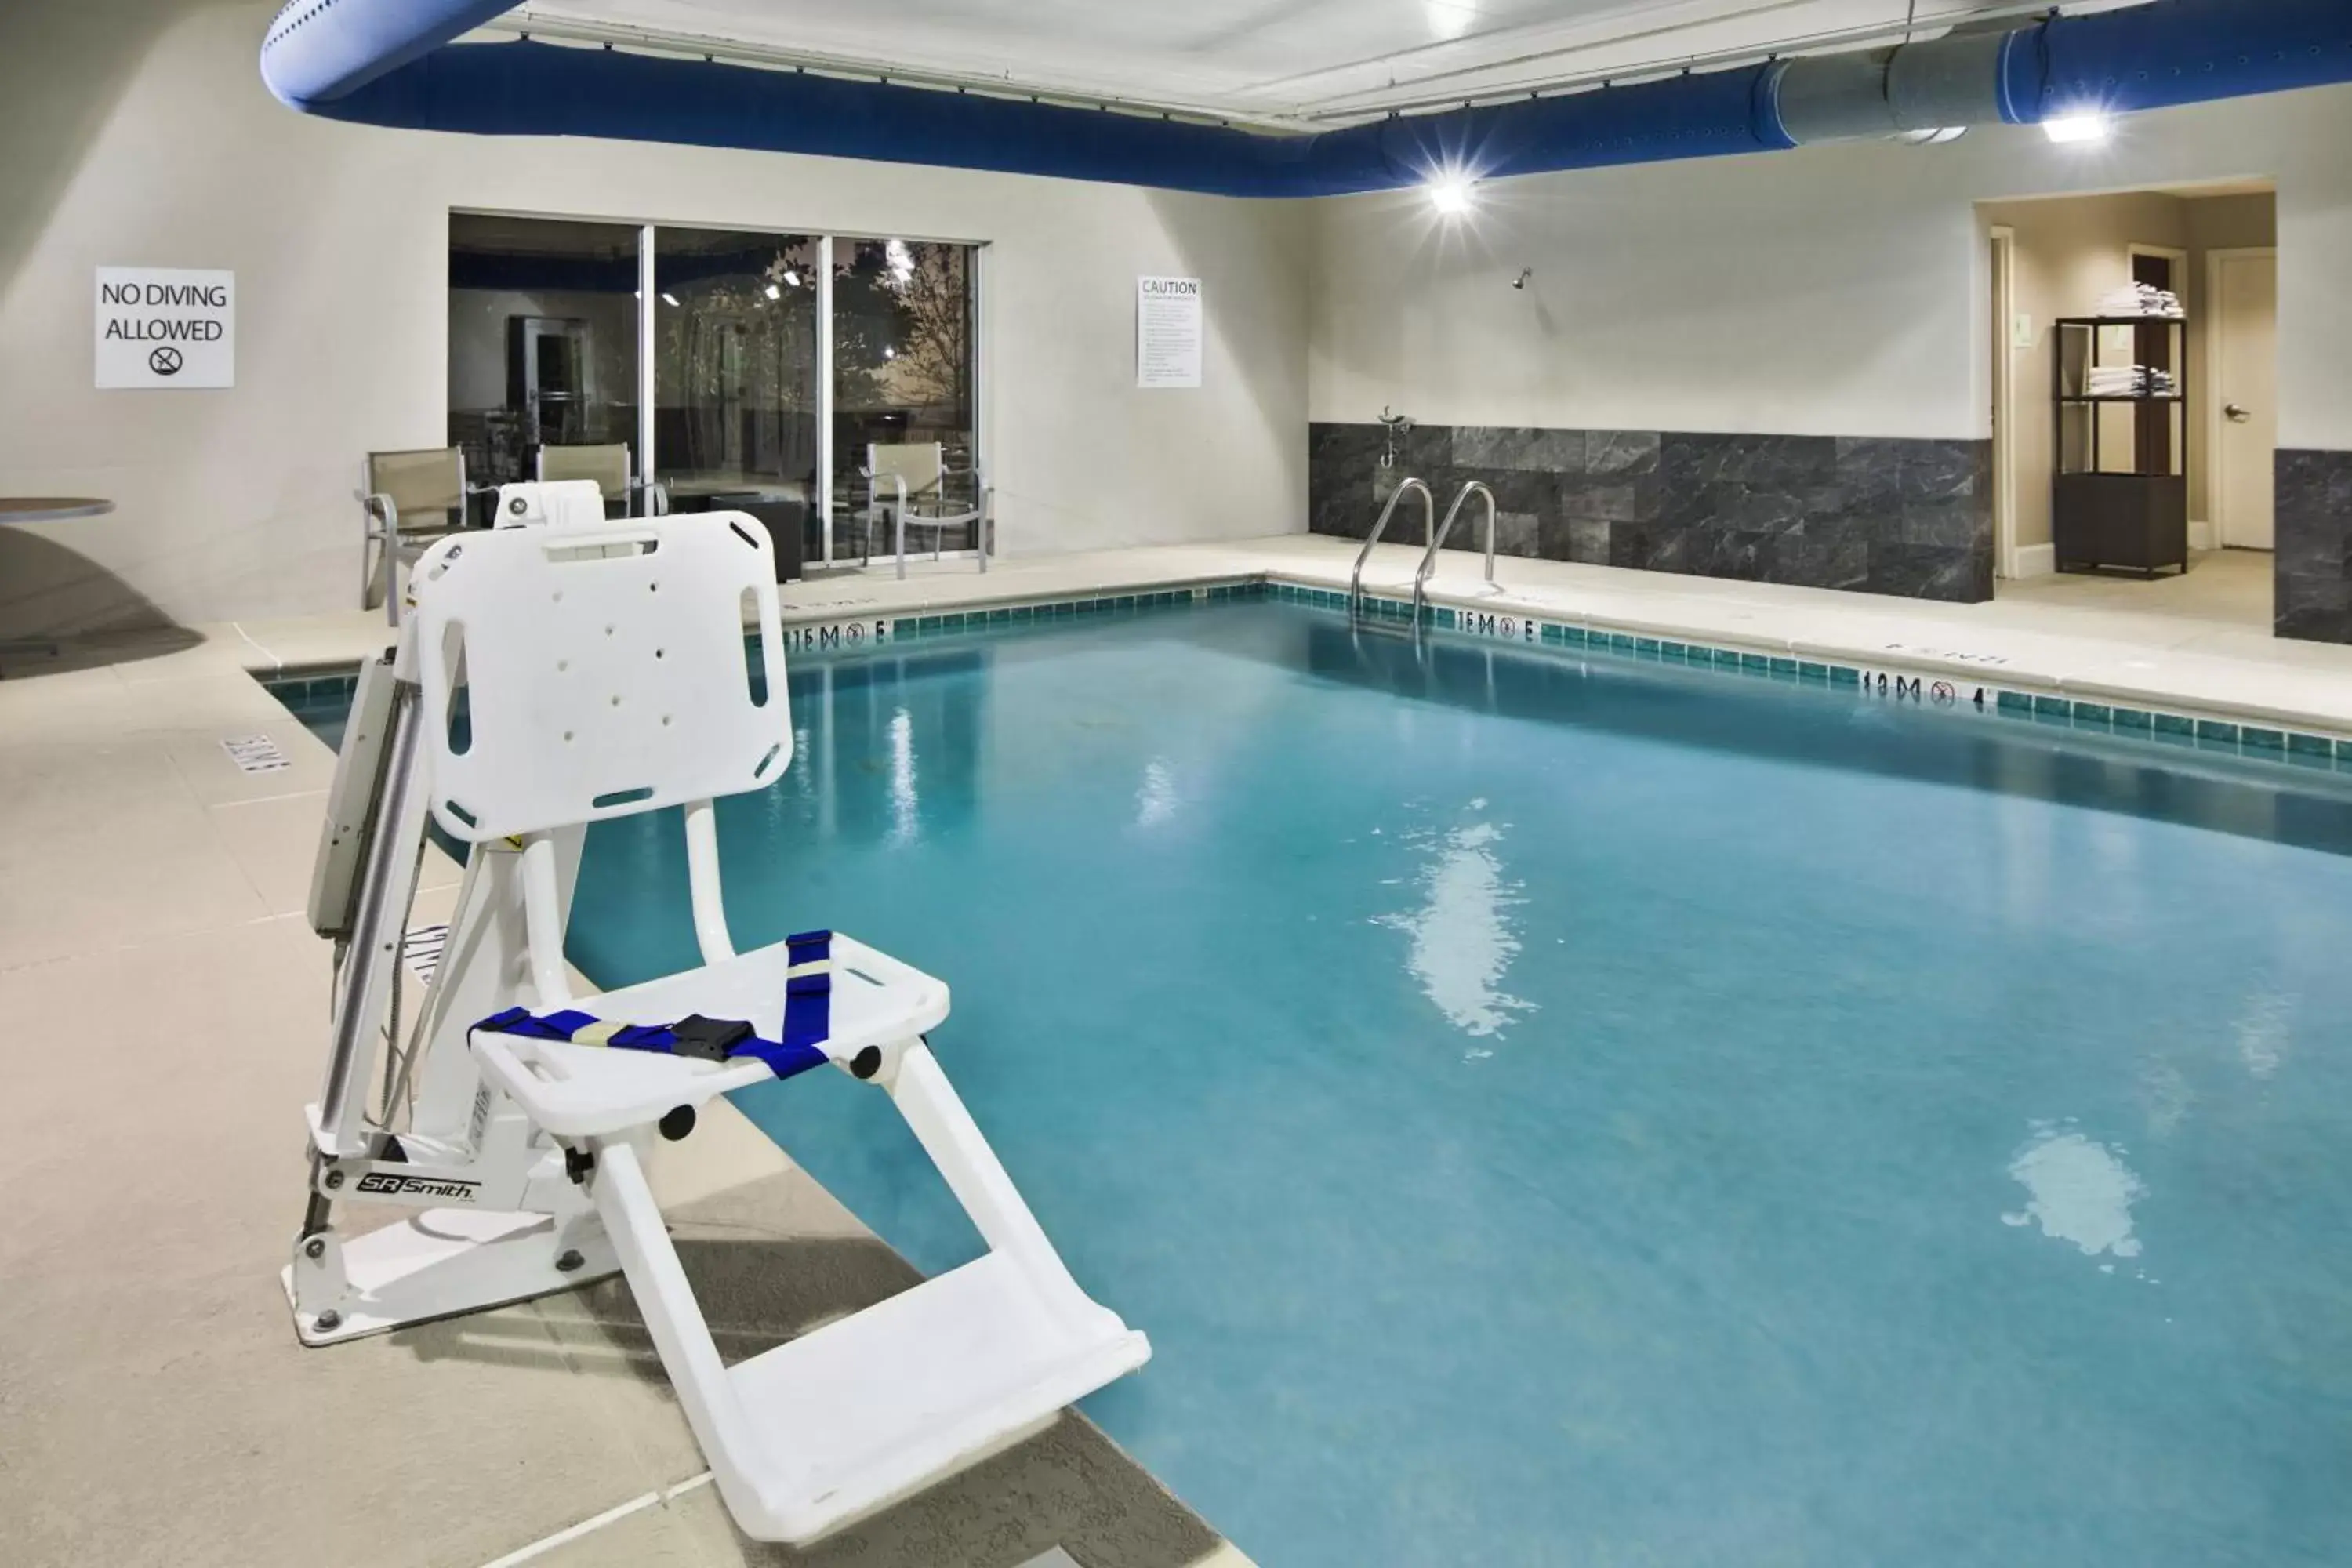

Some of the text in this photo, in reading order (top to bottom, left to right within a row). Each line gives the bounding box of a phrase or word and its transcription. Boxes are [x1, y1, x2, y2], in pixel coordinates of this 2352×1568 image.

[103, 283, 227, 307] NO DIVING
[1142, 280, 1197, 294] CAUTION
[105, 318, 223, 340] ALLOWED
[361, 1175, 472, 1198] SR Smith
